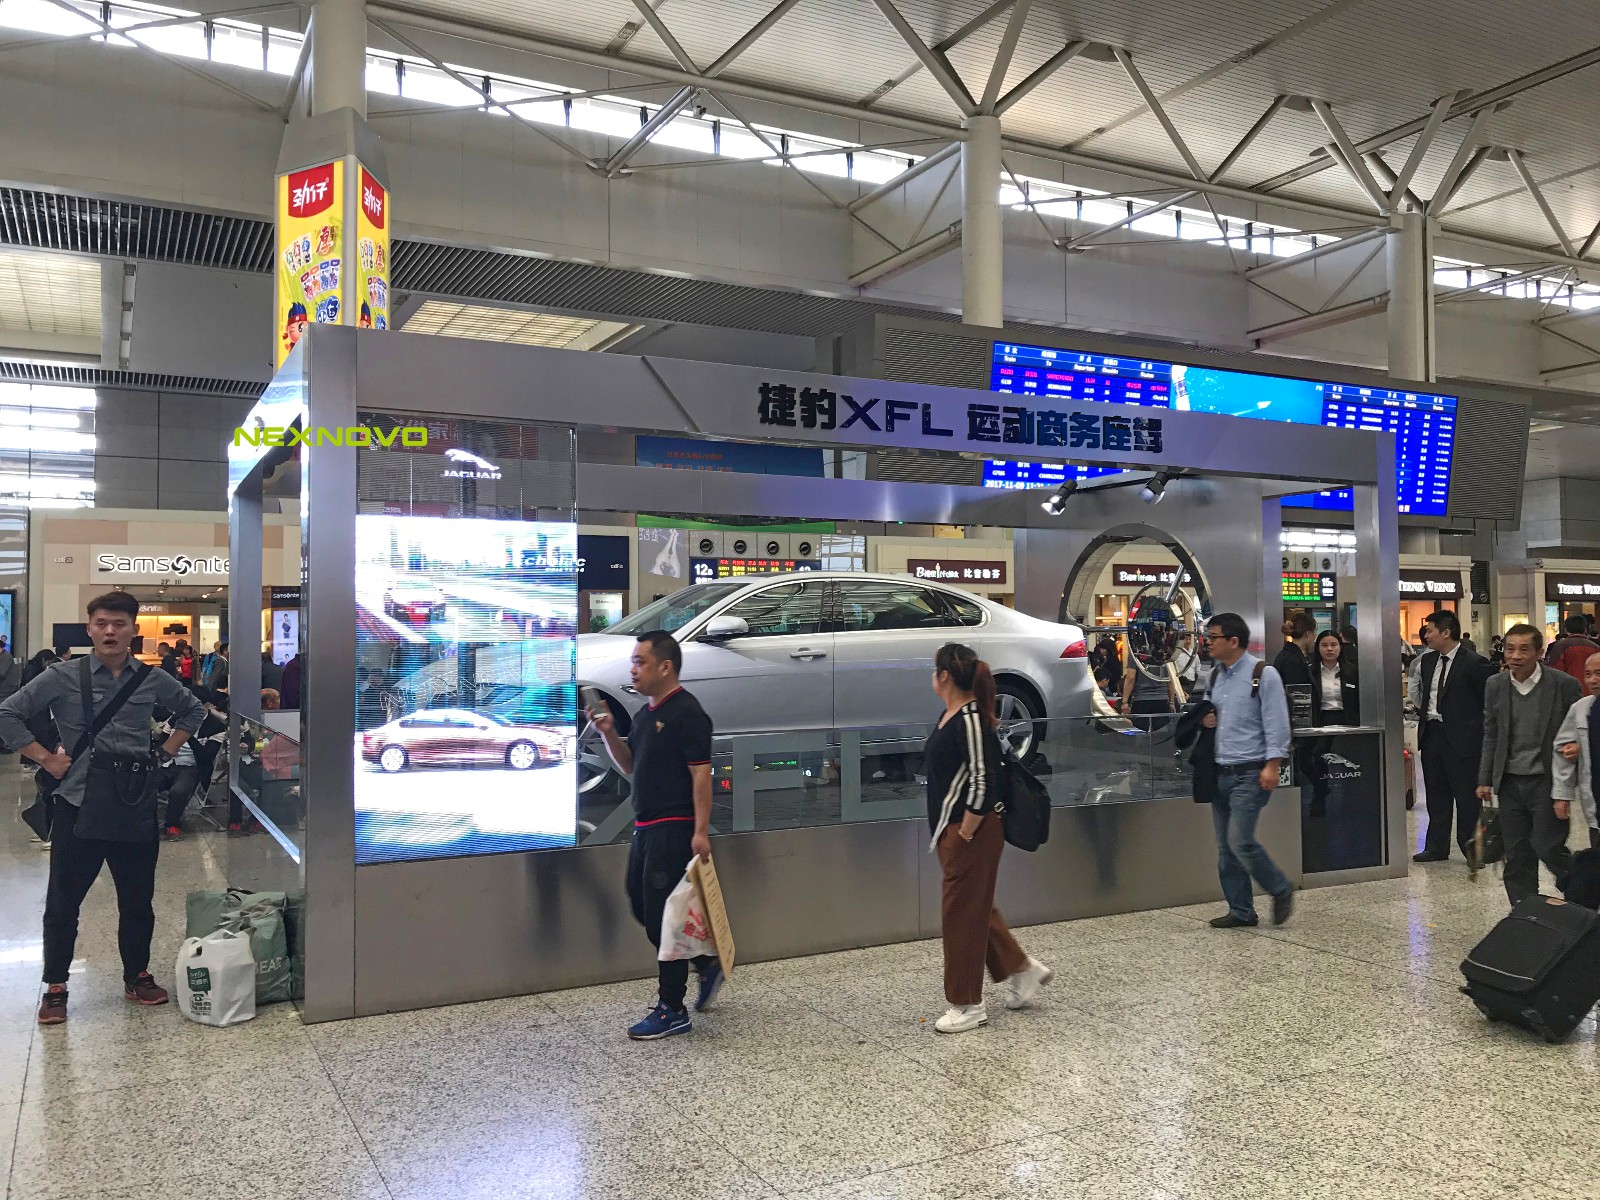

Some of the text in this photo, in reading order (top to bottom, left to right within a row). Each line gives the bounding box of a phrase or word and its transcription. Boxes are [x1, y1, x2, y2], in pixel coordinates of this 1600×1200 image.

[292, 178, 328, 214] 劲仔
[364, 186, 382, 216] 劲仔
[443, 470, 502, 480] JAGUAR
[985, 480, 1024, 489] 2017-11-09
